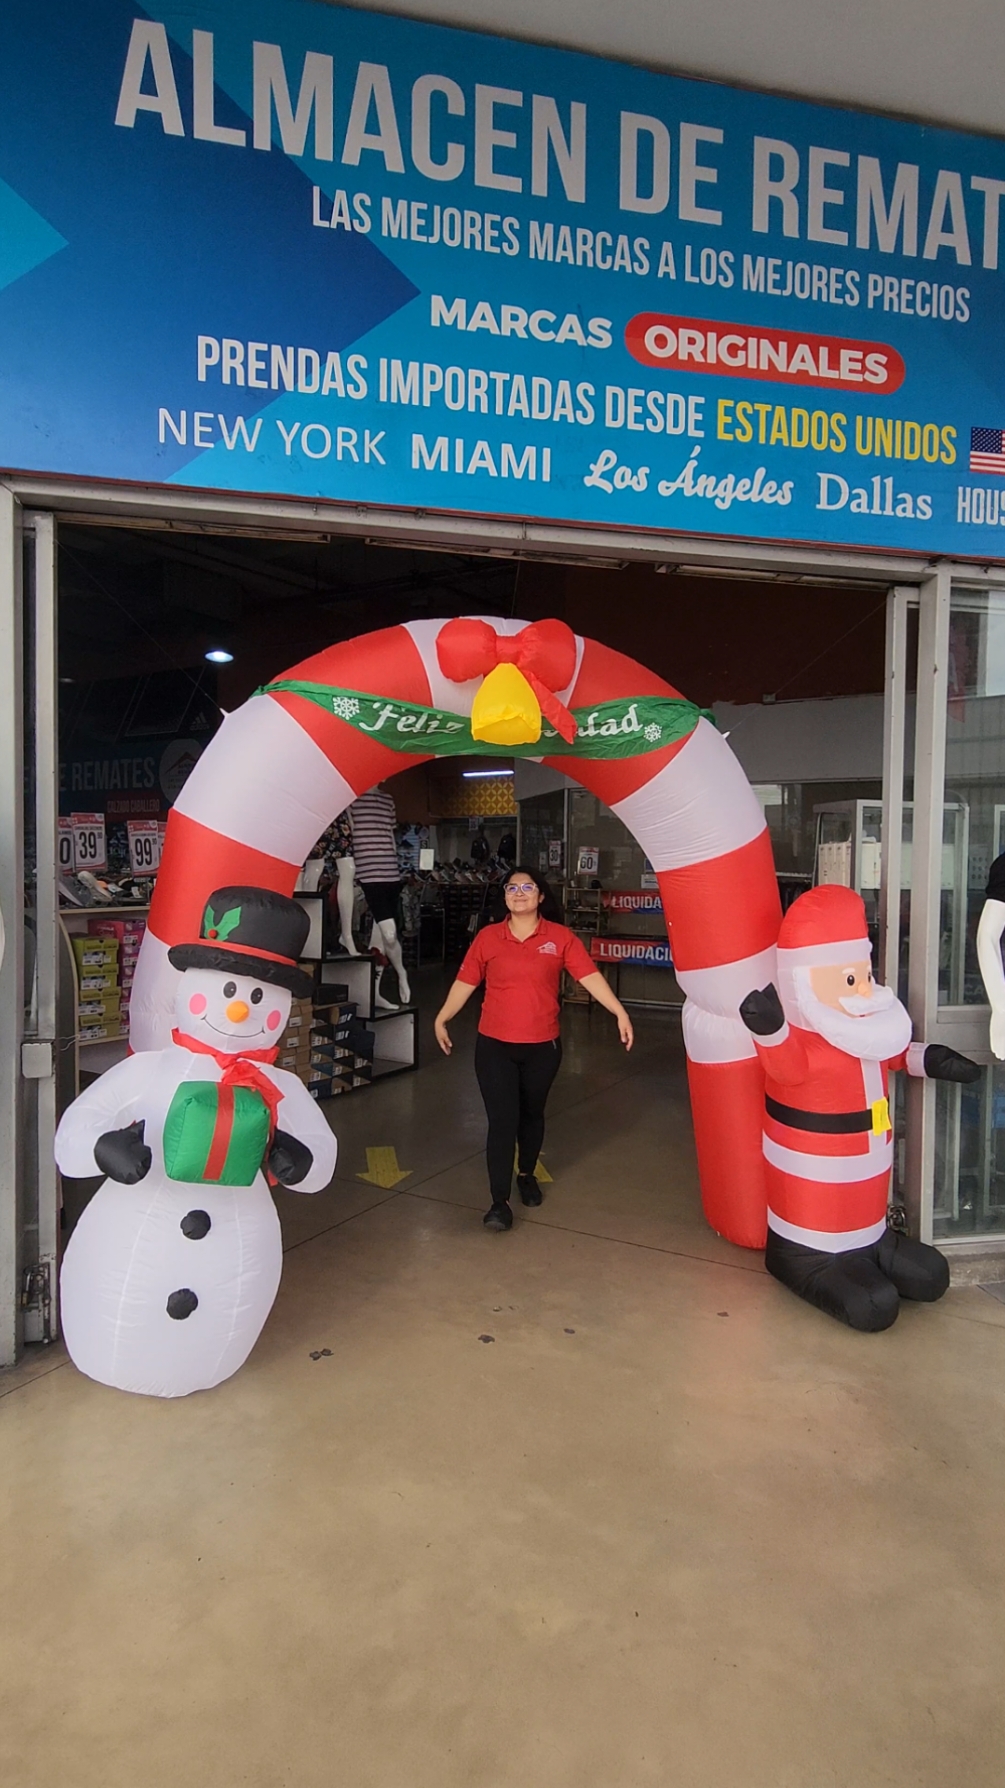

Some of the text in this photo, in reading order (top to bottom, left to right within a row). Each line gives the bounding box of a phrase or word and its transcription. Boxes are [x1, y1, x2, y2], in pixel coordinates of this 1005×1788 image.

[114, 18, 1005, 270] ALMACEN DE REMAT
[312, 186, 972, 323] LAS MEJORES MARCAS A LOS MEJORES PRECIOS
[430, 295, 888, 385] MARCAS ORIGINALES
[197, 335, 957, 465] PRENDAS IMPORTADAS DESDE ESTADOS UNIDOS
[157, 407, 387, 465] NEW YORK
[411, 433, 552, 483] MIAMI
[583, 445, 794, 511] Los Ángeles
[815, 472, 933, 520] Dallas
[358, 702, 464, 734] Feliz
[71, 757, 155, 792] REMATES
[79, 831, 97, 859] 39
[134, 838, 153, 866] 99
[580, 856, 594, 870] 60
